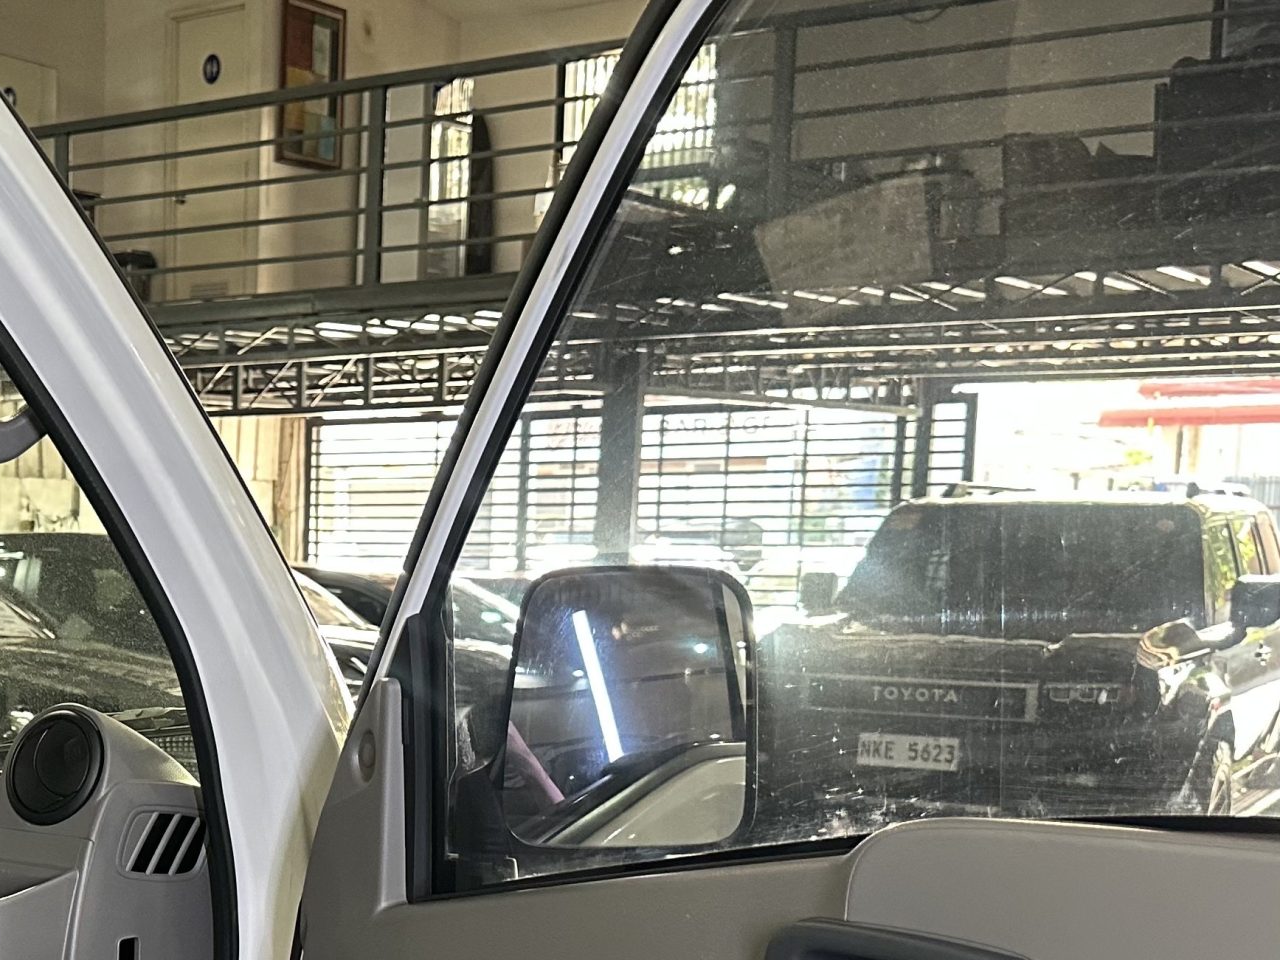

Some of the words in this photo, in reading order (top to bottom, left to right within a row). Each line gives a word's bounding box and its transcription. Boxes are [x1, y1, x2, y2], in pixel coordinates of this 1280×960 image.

[872, 685, 958, 702] TOYOTA
[859, 740, 896, 760] NKE
[907, 742, 955, 763] 5623
